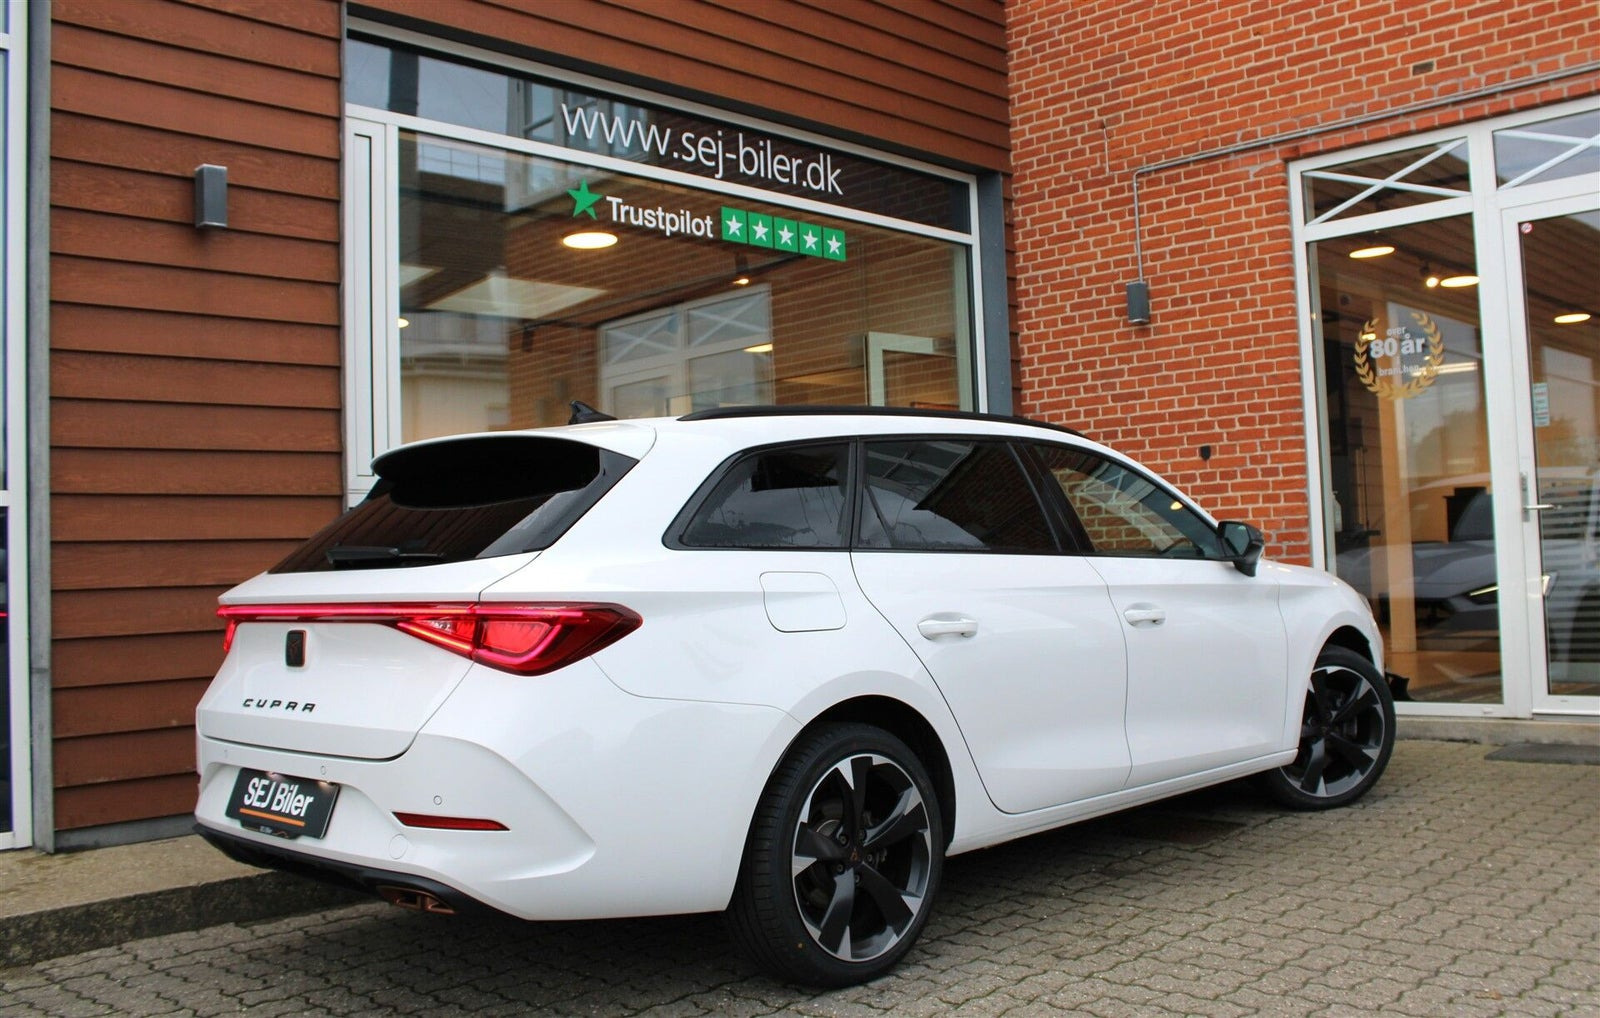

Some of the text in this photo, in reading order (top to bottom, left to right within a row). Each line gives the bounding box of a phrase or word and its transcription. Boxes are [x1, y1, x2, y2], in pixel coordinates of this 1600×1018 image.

[562, 103, 843, 195] www.sej-biler.dk
[606, 196, 713, 238] Trustpilot
[1370, 333, 1425, 358] 80 år
[1387, 326, 1406, 336] over
[243, 698, 316, 713] CUPRA
[243, 778, 313, 816] SEJ Biler
